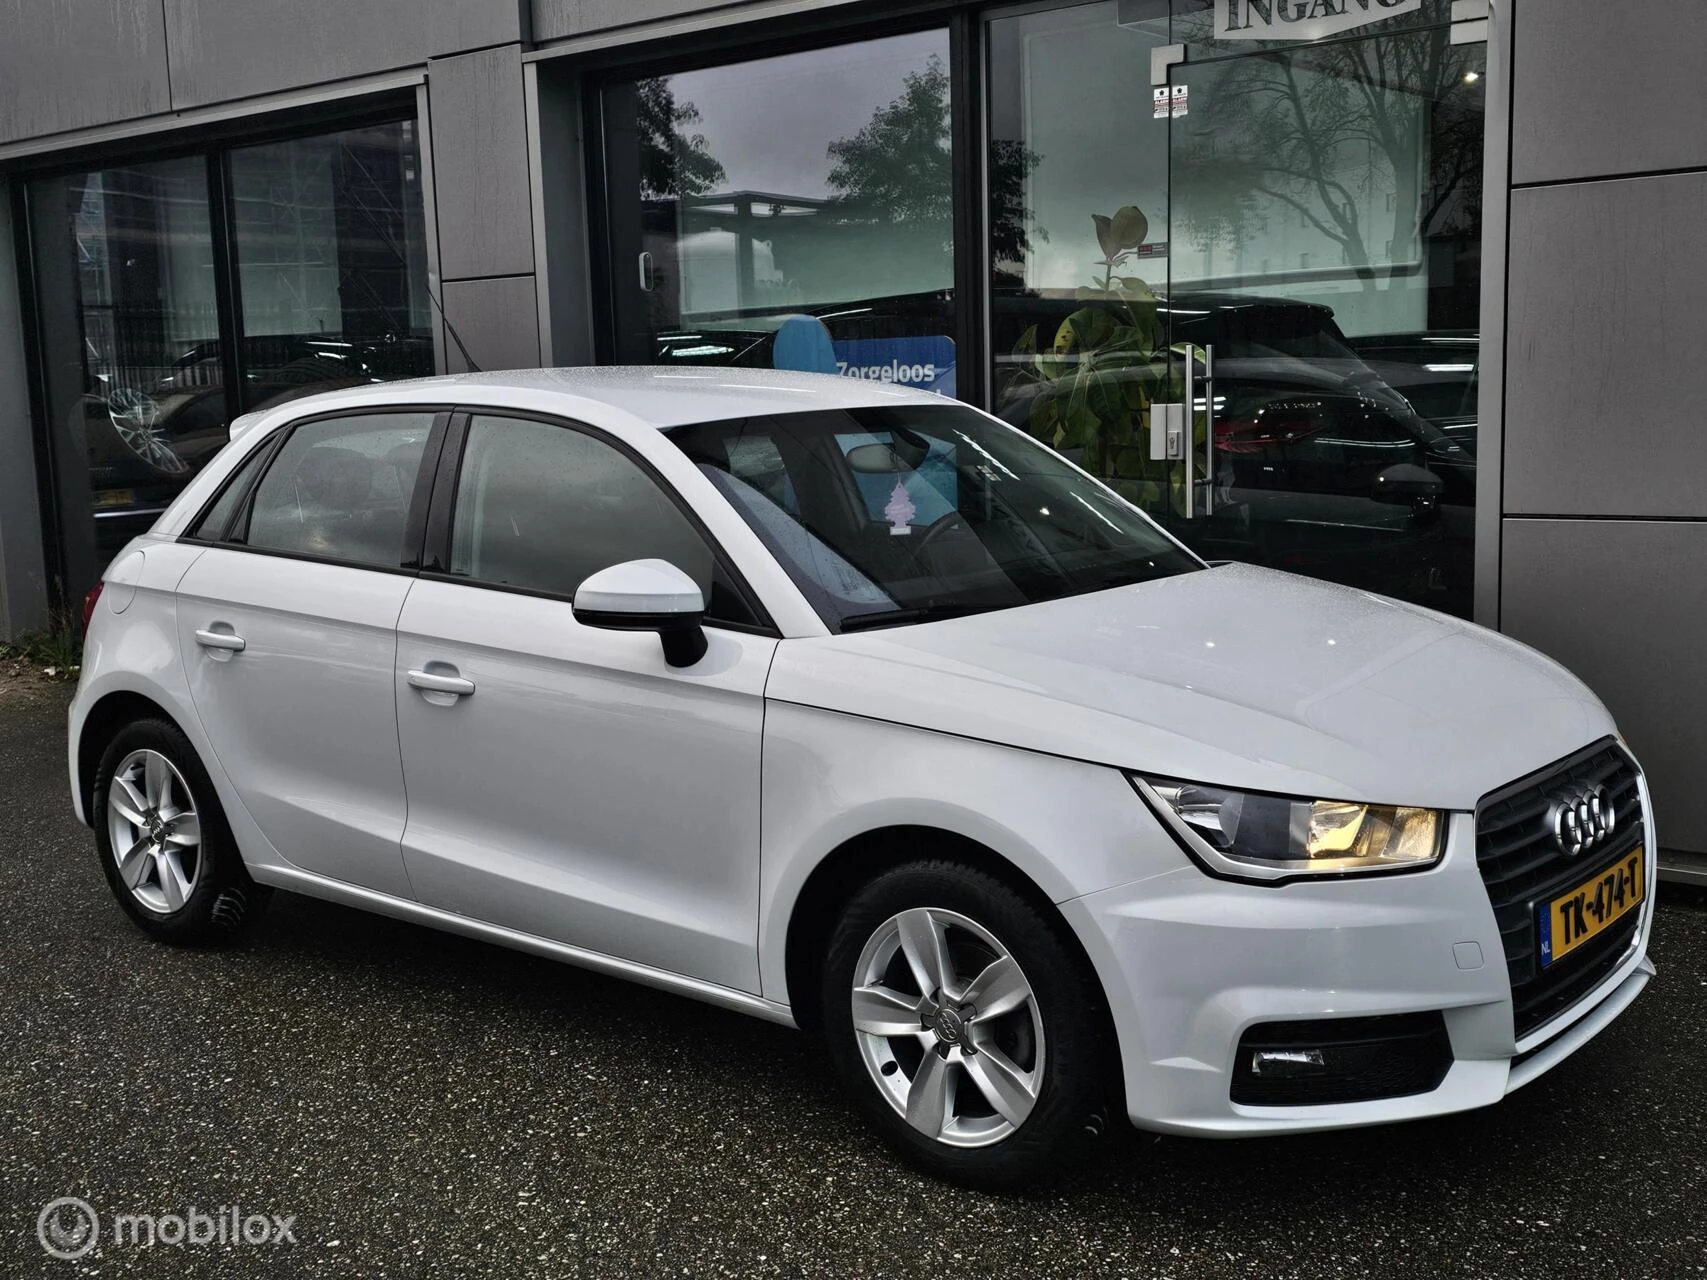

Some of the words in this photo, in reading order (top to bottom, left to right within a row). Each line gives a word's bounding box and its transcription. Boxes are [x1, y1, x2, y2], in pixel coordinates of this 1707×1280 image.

[836, 358, 935, 383] Zorgeloos
[1560, 857, 1638, 945] TK-474-T
[1541, 942, 1551, 955] NL
